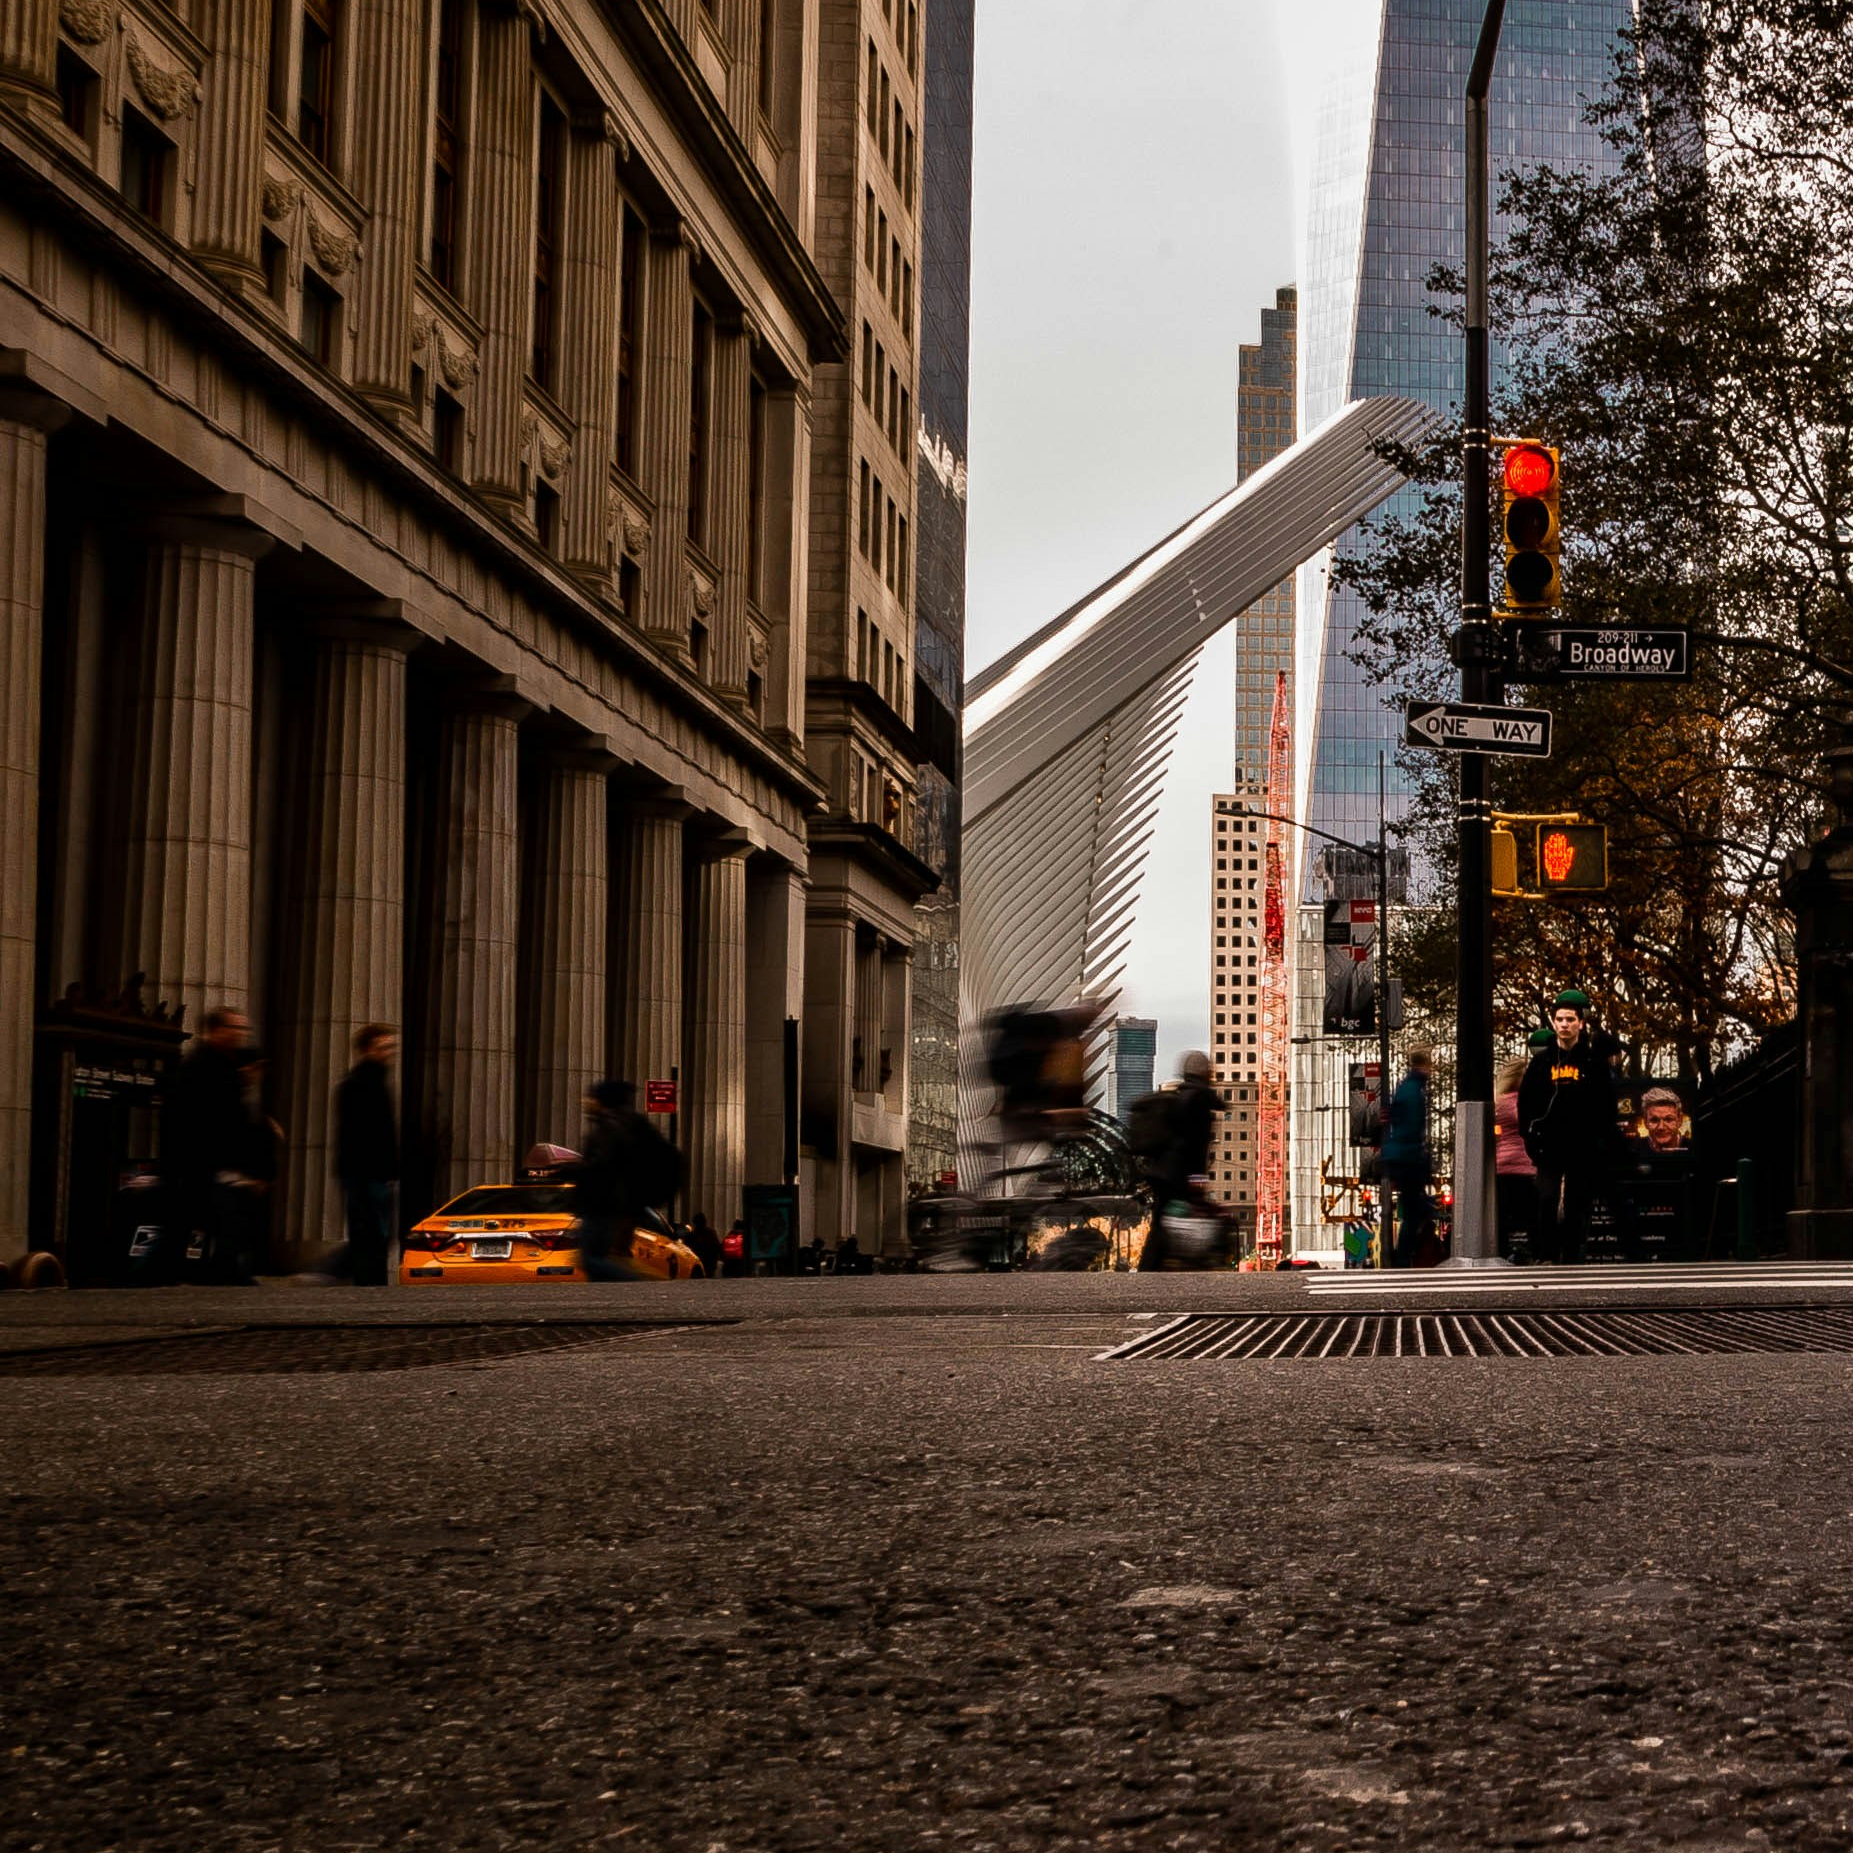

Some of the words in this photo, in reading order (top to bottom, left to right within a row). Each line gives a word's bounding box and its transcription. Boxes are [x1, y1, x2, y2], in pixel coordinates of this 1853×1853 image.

[1597, 632, 1638, 644] 209-211
[1570, 642, 1676, 670] Broadway
[1583, 664, 1616, 673] CANYON
[1425, 716, 1469, 737] ONE
[1491, 721, 1538, 742] WAY
[1340, 1017, 1361, 1030] bgc
